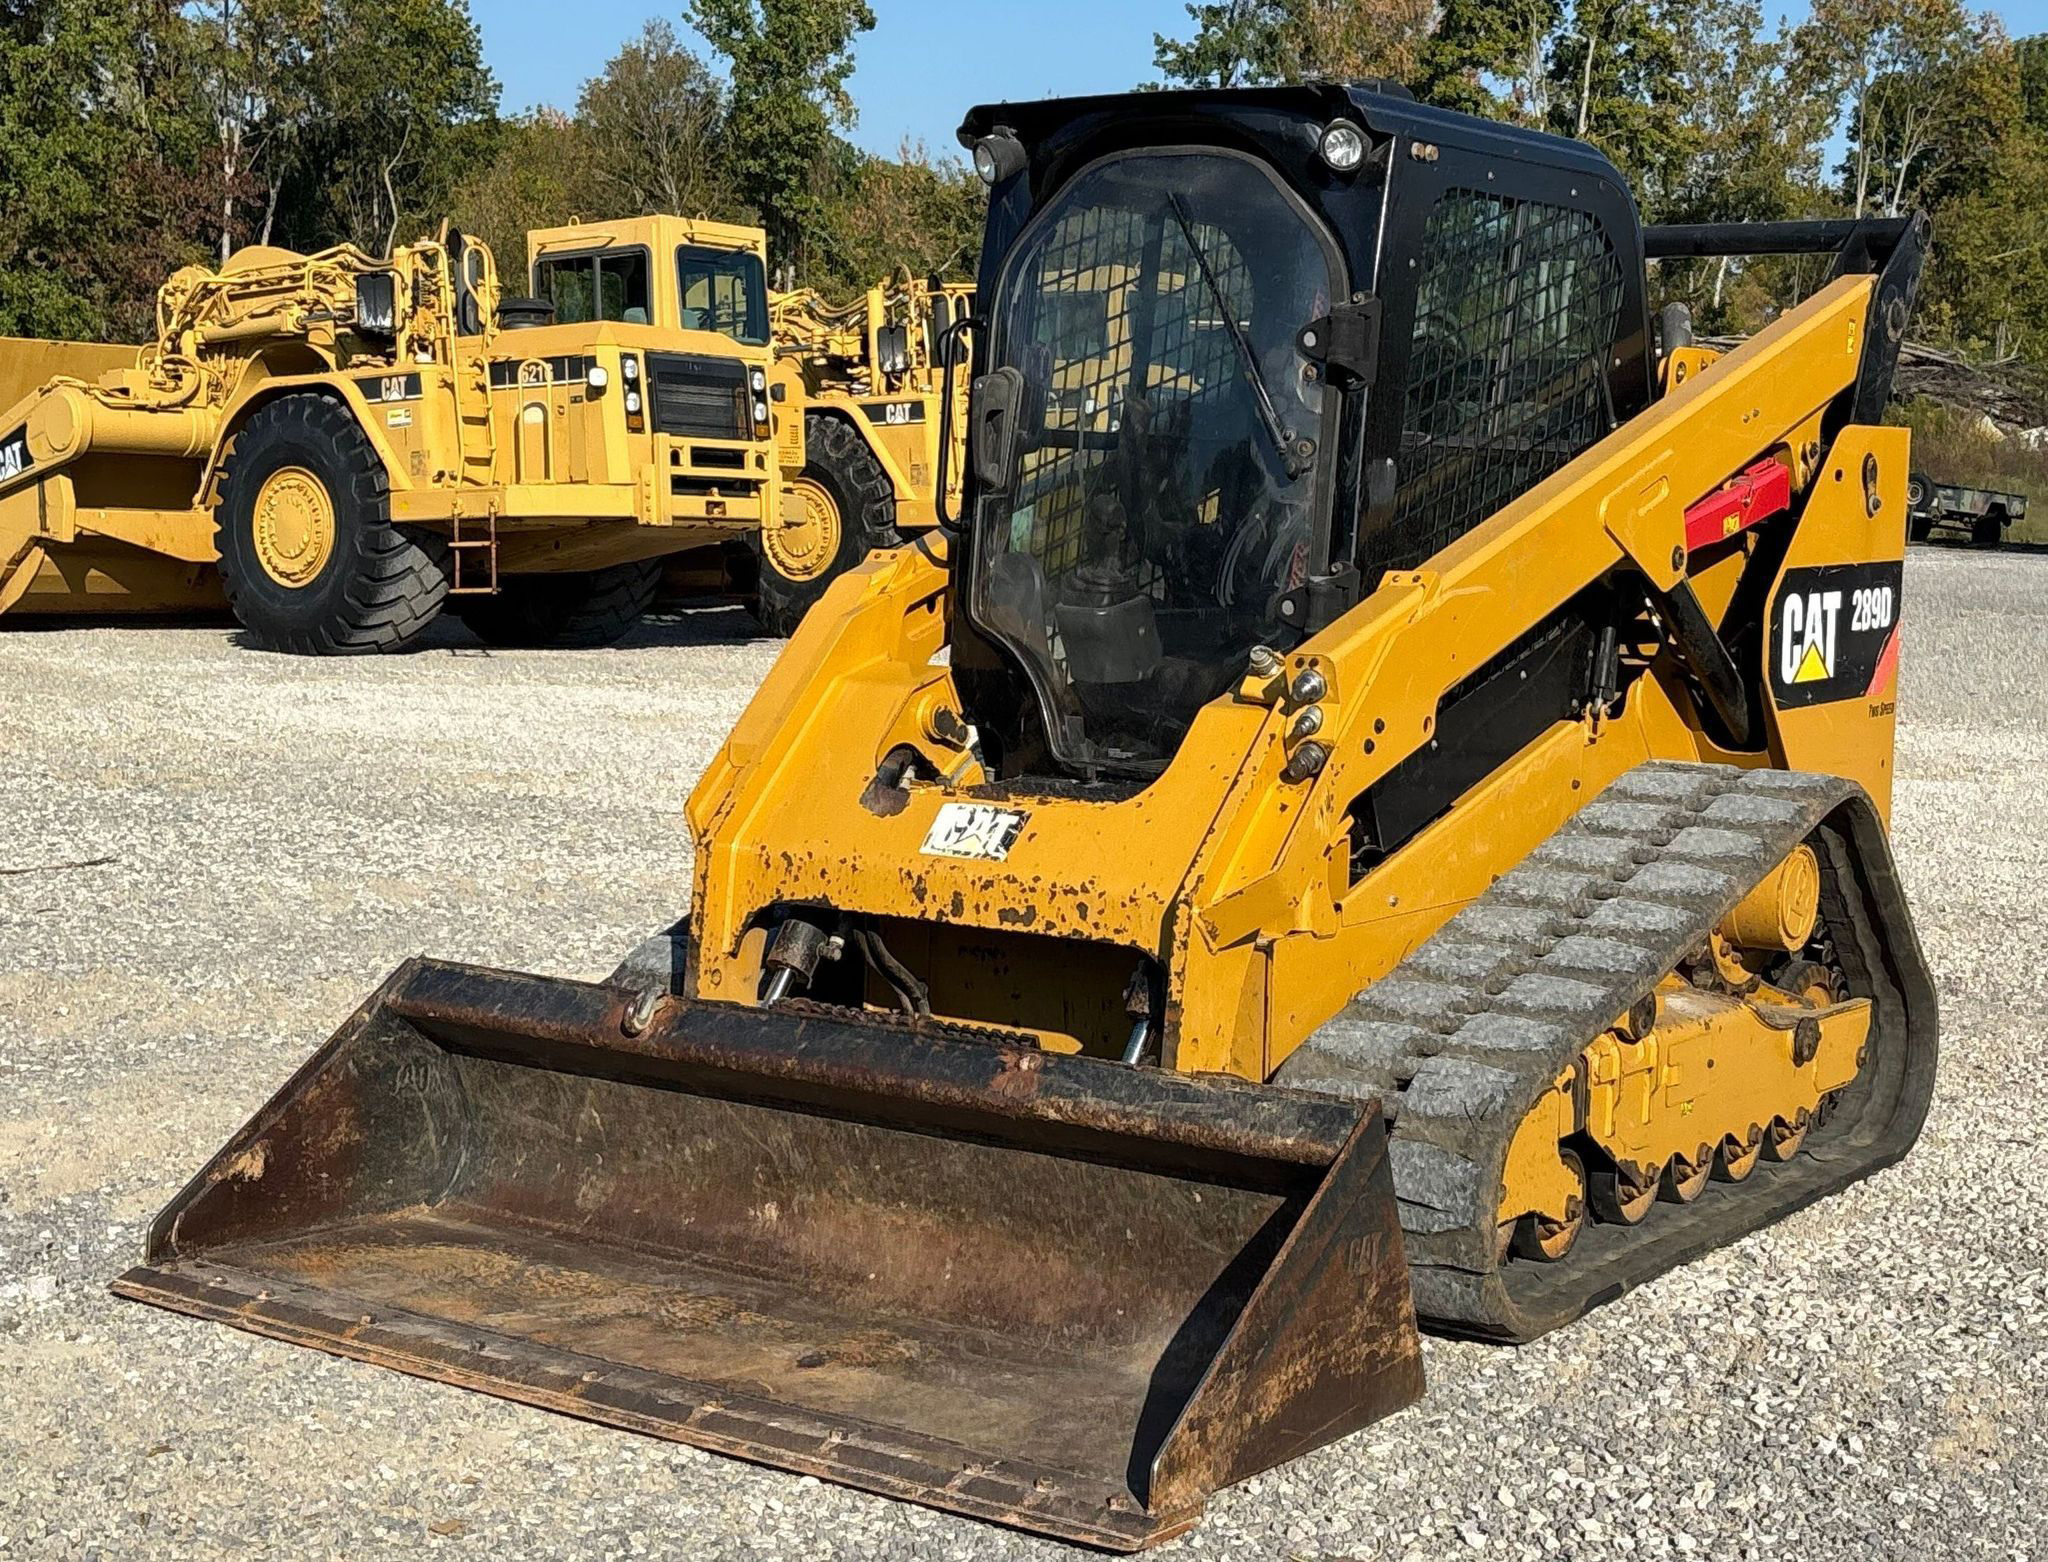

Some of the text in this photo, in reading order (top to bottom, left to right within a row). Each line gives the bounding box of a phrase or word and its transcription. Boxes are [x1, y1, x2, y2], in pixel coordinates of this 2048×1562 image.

[381, 376, 408, 401] CAT
[886, 403, 912, 424] CAT
[1781, 586, 1892, 684] CAT 289D
